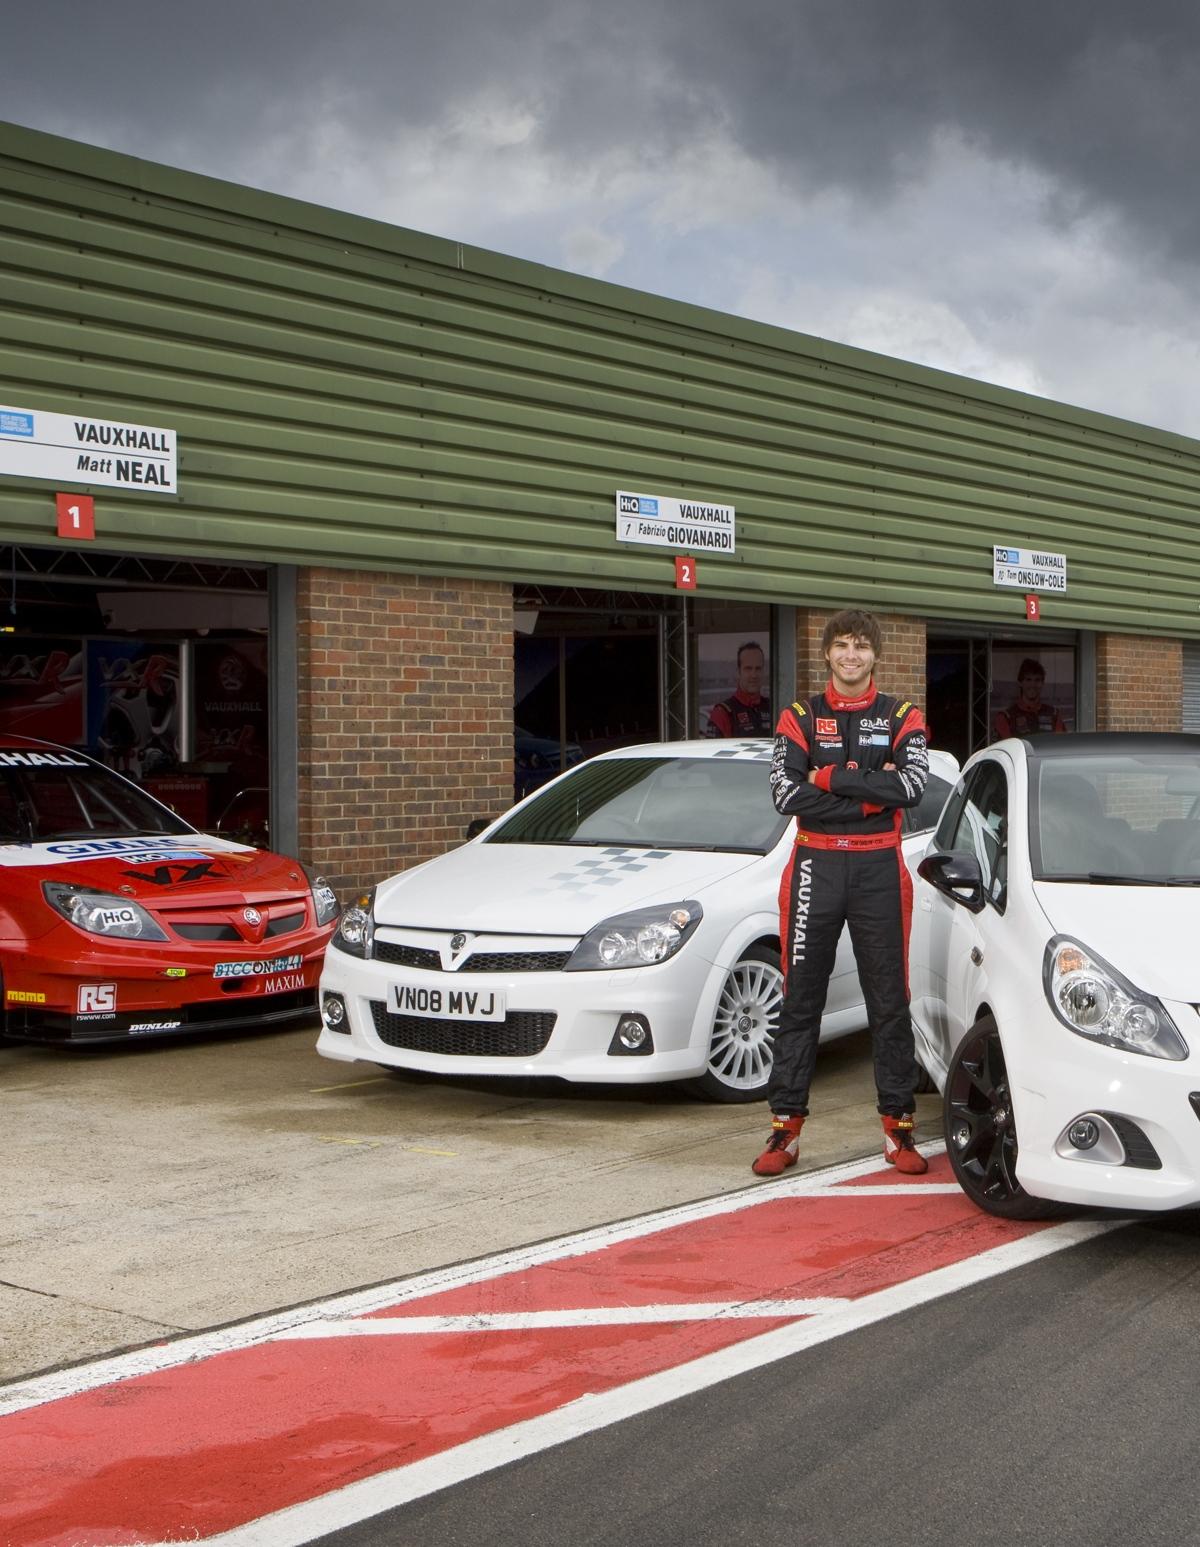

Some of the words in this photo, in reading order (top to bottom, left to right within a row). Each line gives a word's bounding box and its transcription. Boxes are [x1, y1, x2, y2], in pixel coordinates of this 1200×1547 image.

[74, 422, 170, 452] VAUXHALL
[77, 455, 112, 473] Matt
[116, 459, 170, 486] NEAL
[621, 497, 639, 512] HiQ
[67, 506, 80, 528] 1
[680, 504, 731, 524] VAUXHALL
[638, 522, 666, 537] Fabrizio
[667, 526, 731, 549] GIOVANARDI
[1032, 554, 1064, 568] VAUXHALL
[682, 565, 691, 582] 2
[1018, 571, 1064, 588] ONSLOW-COLE
[1030, 601, 1036, 614] 3
[204, 701, 263, 712] VAUXHALL
[0, 753, 89, 766] HALL
[47, 838, 198, 855] GMAC
[103, 910, 134, 924] HiQ
[793, 858, 812, 966] VAUXHALL
[264, 975, 305, 994] MAXIM
[7, 990, 46, 1002] momo
[80, 986, 114, 1011] RS
[394, 985, 442, 1012] VN08
[449, 991, 495, 1015] MVJ
[76, 1013, 116, 1021] rswww.com
[129, 1021, 181, 1032] DUNLOP
